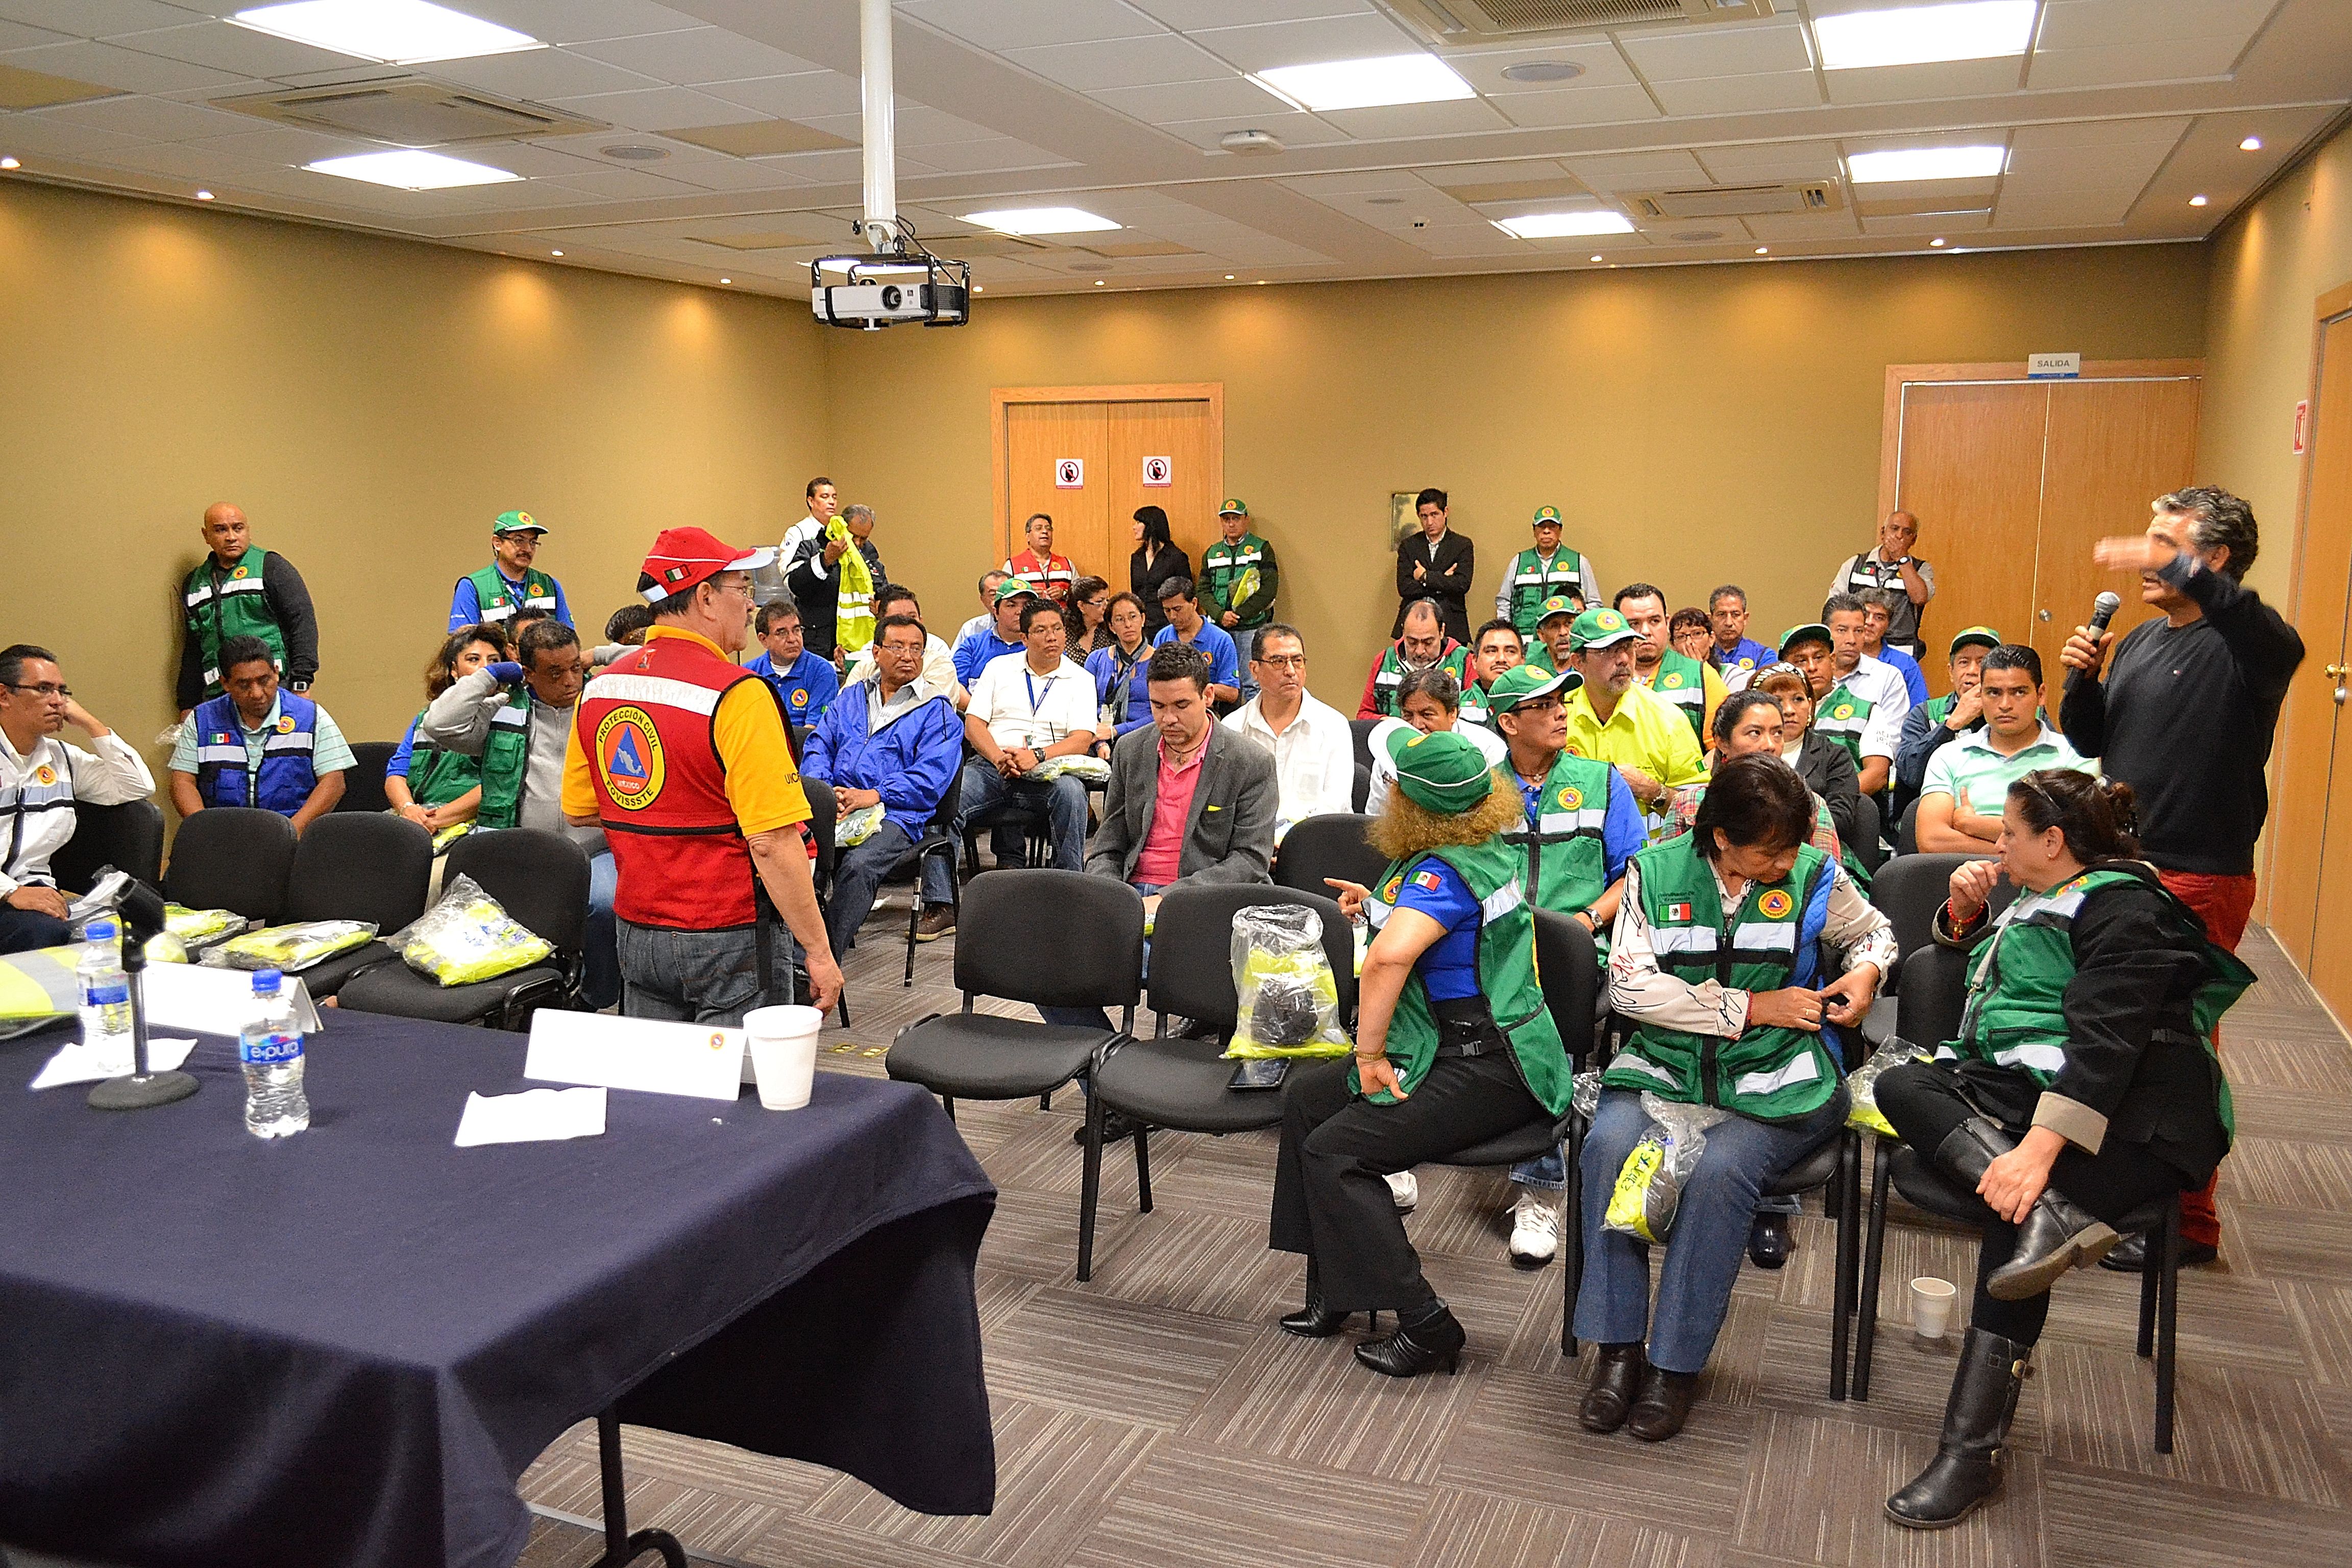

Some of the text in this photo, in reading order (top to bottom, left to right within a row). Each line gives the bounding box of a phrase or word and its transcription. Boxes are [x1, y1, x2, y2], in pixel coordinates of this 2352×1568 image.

[598, 709, 658, 751] PROTECCIÓN CIVIL
[606, 779, 654, 806] FOVISSSTE
